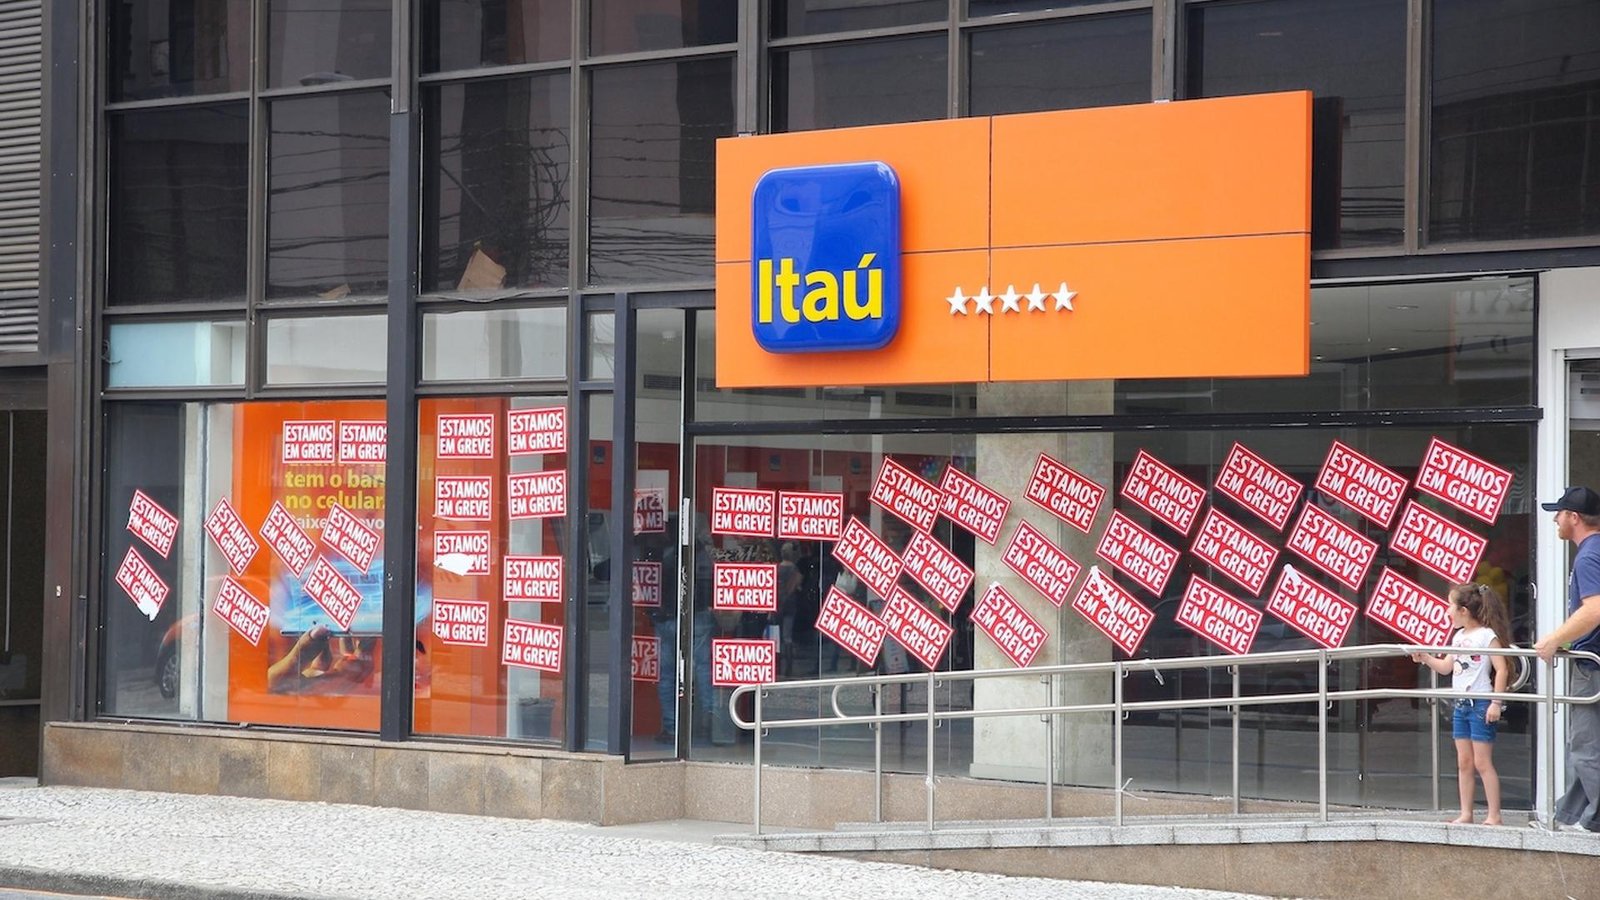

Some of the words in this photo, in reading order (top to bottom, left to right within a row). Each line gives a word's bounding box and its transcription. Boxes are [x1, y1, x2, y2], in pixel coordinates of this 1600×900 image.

[758, 253, 882, 323] Itaú
[286, 426, 332, 442] ESTAMOS
[441, 439, 454, 453] EM
[458, 438, 490, 453] GREVE
[442, 420, 490, 436] ESTAMOS
[512, 413, 562, 433] ESTAMOS
[512, 434, 525, 450] EM
[529, 432, 562, 449] GREVE
[286, 444, 298, 458] EM
[301, 444, 331, 458] GREVE
[343, 444, 355, 458] EM
[1430, 447, 1505, 497] ESTAMOS
[285, 471, 324, 488] tem
[329, 474, 342, 488] o
[440, 482, 488, 498] ESTAMOS
[512, 477, 562, 497] ESTAMOS
[882, 465, 939, 512] ESTAMOS
[945, 473, 1005, 521] ESTAMOS
[1037, 461, 1099, 509] ESTAMOS
[1136, 458, 1199, 511] ESTAMOS
[1222, 469, 1244, 494] EM
[1241, 482, 1286, 523] GREVE
[1230, 451, 1296, 506] ESTAMOS
[1322, 469, 1346, 494] EM
[1343, 481, 1392, 520] GREVE
[1330, 449, 1401, 502] ESTAMOS
[1423, 467, 1447, 492] EM
[1446, 478, 1497, 517] GREVE
[134, 497, 174, 539] ESTAMOS
[285, 495, 312, 509] no
[292, 514, 327, 529] aixe
[439, 500, 452, 514] EM
[456, 500, 488, 515] GREVE
[512, 498, 526, 514] EM
[529, 496, 562, 513] GREVE
[716, 494, 771, 514] ESTAMOS
[716, 513, 731, 529] EM
[735, 514, 771, 531] GREVE
[783, 498, 839, 517] ESTAMOS
[783, 517, 798, 533] EM
[801, 518, 838, 535] GREVE
[876, 483, 895, 505] EM
[894, 494, 932, 527] GREVE
[957, 502, 998, 537] GREVE
[1030, 479, 1051, 502] EM
[1049, 490, 1092, 526] GREVE
[1128, 476, 1149, 500] EM
[1147, 489, 1191, 528] GREVE
[143, 523, 169, 552] GREVE
[209, 516, 224, 537] EM
[219, 531, 246, 569] GREVE
[217, 504, 254, 558] ESTAMOS
[264, 521, 279, 542] EM
[276, 535, 304, 572] GREVE
[271, 508, 311, 560] ESTAMOS
[325, 525, 340, 545] EM
[338, 535, 369, 568] GREVE
[331, 510, 375, 554] ESTAMOS
[438, 536, 486, 553] ESTAMOS
[846, 525, 899, 579] ESTAMOS
[1110, 519, 1174, 572] ESTAMOS
[1206, 516, 1271, 571] ESTAMOS
[1302, 510, 1371, 565] ESTAMOS
[1398, 529, 1422, 554] EM
[1421, 541, 1472, 580] GREVE
[1405, 509, 1480, 562] ESTAMOS
[120, 567, 134, 587] EM
[126, 554, 164, 602] ESTAMOS
[508, 562, 558, 579] ESTAMOS
[718, 569, 773, 588] ESTAMOS
[838, 540, 858, 563] EM
[855, 554, 891, 592] GREVE
[906, 550, 925, 574] EM
[921, 564, 959, 605] GREVE
[913, 533, 968, 590] ESTAMOS
[1008, 544, 1028, 569] EM
[1025, 559, 1065, 599] GREVE
[1016, 528, 1074, 584] ESTAMOS
[1103, 537, 1124, 561] EM
[1121, 549, 1165, 589] GREVE
[1198, 534, 1220, 558] EM
[1218, 547, 1263, 588] GREVE
[1293, 529, 1317, 555] EM
[1314, 543, 1362, 583] GREVE
[223, 582, 264, 625] ESTAMOS
[308, 575, 324, 596] EM
[321, 588, 351, 624] GREVE
[315, 562, 358, 612] ESTAMOS
[507, 581, 521, 596] EM
[525, 581, 558, 597] GREVE
[718, 589, 733, 604] EM
[737, 589, 772, 605] GREVE
[1087, 576, 1147, 632] ESTAMOS
[1189, 583, 1256, 635] ESTAMOS
[1281, 576, 1351, 626] ESTAMOS
[1373, 596, 1397, 622] EM
[1381, 576, 1451, 632] ESTAMOS
[217, 596, 232, 616] EM
[230, 607, 259, 639] GREVE
[436, 623, 449, 638] EM
[453, 624, 484, 641] GREVE
[437, 604, 485, 624] ESTAMOS
[508, 625, 559, 649] ESTAMOS
[821, 611, 840, 634] EM
[838, 623, 876, 660] GREVE
[828, 593, 882, 644] ESTAMOS
[890, 593, 948, 647] ESTAMOS
[977, 604, 998, 628] EM
[993, 620, 1031, 662] GREVE
[987, 590, 1042, 649] ESTAMOS
[1078, 592, 1099, 615] EM
[1095, 606, 1138, 648] GREVE
[1182, 602, 1204, 627] EM
[1203, 614, 1248, 652] GREVE
[1274, 593, 1297, 616] EM
[1295, 605, 1342, 642] GREVE
[506, 644, 521, 661] EM
[523, 647, 557, 666] GREVE
[717, 645, 771, 663] ESTAMOS
[899, 623, 939, 662] GREVE
[717, 664, 731, 679] EM
[735, 665, 771, 680] GREVE
